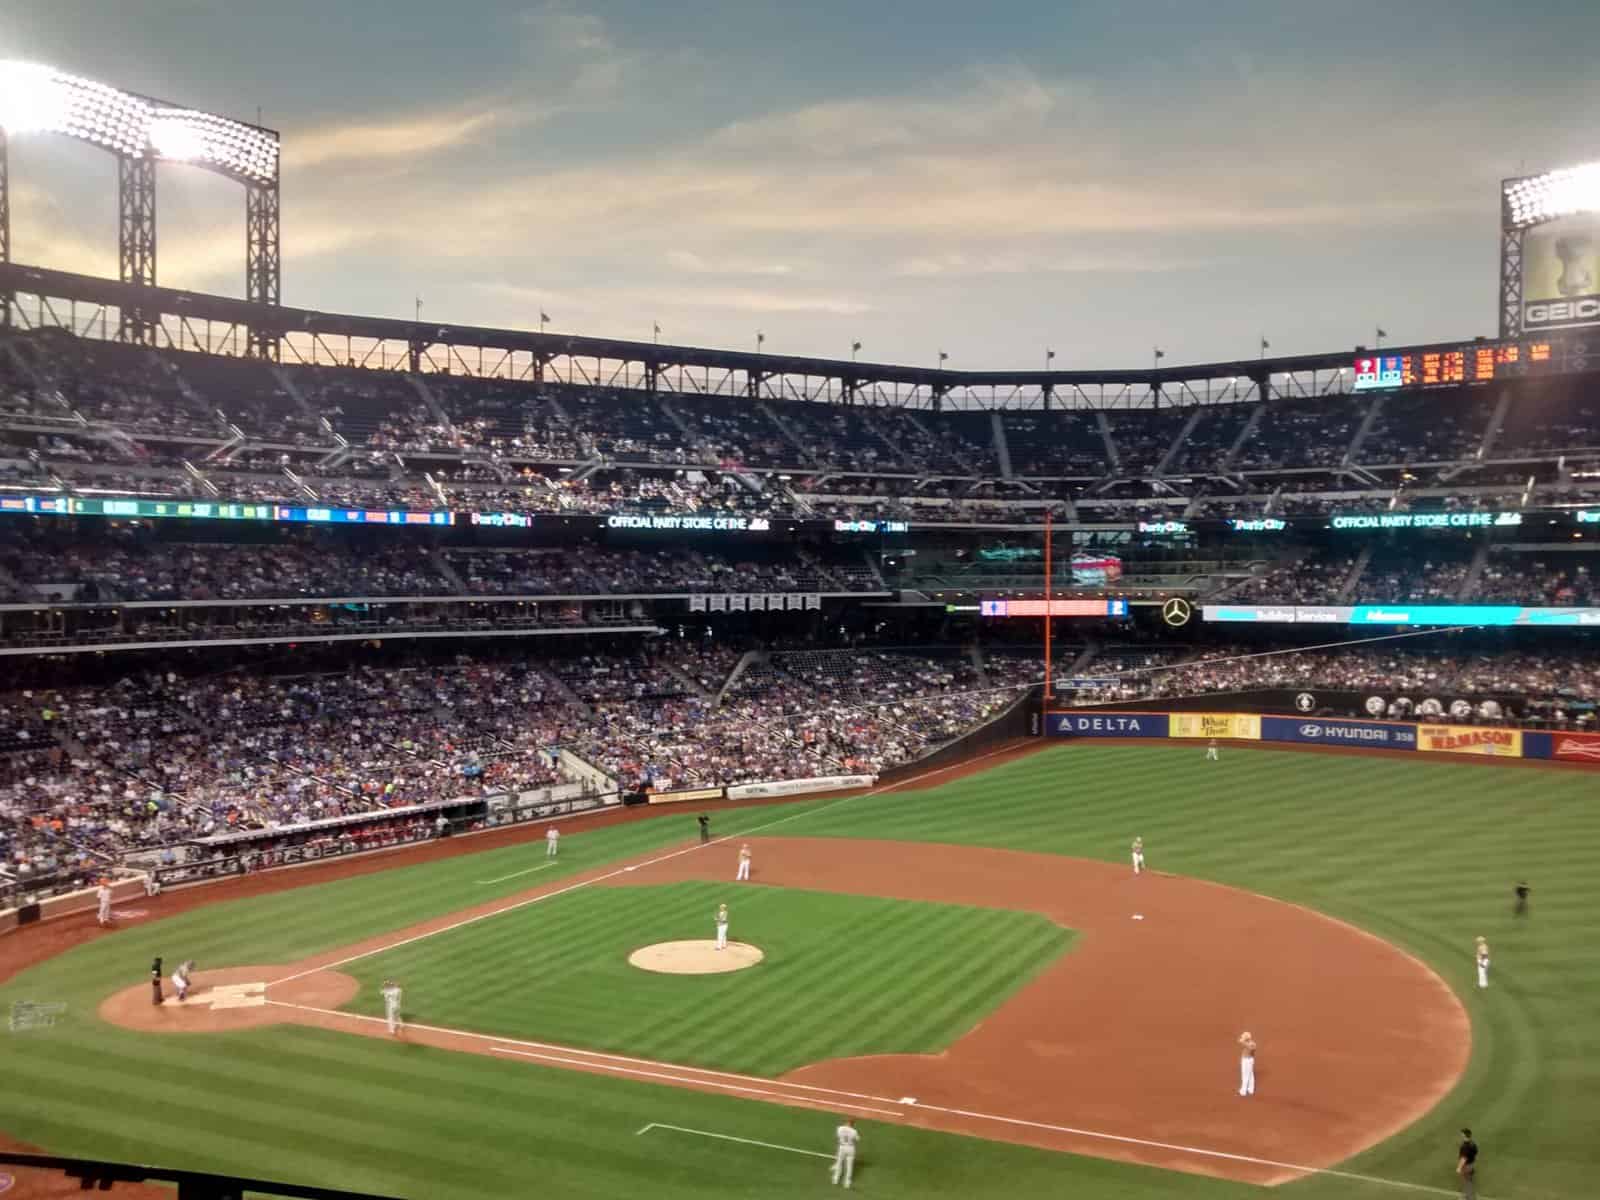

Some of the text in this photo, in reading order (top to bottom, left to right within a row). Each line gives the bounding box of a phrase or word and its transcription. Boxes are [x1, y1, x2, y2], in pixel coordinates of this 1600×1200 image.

[608, 515, 651, 529] OFFICIAL
[653, 516, 681, 529] PARTY
[682, 516, 712, 529] STORE
[714, 517, 728, 530] OF
[728, 517, 746, 530] THE
[1333, 515, 1380, 529] OFFICIAL
[1381, 514, 1412, 528] PARTY
[1413, 513, 1449, 527] STORE
[1450, 513, 1467, 527] OF
[1468, 512, 1493, 526] THE
[1078, 717, 1141, 732] DELTA
[1325, 727, 1388, 741] HYUNDAI
